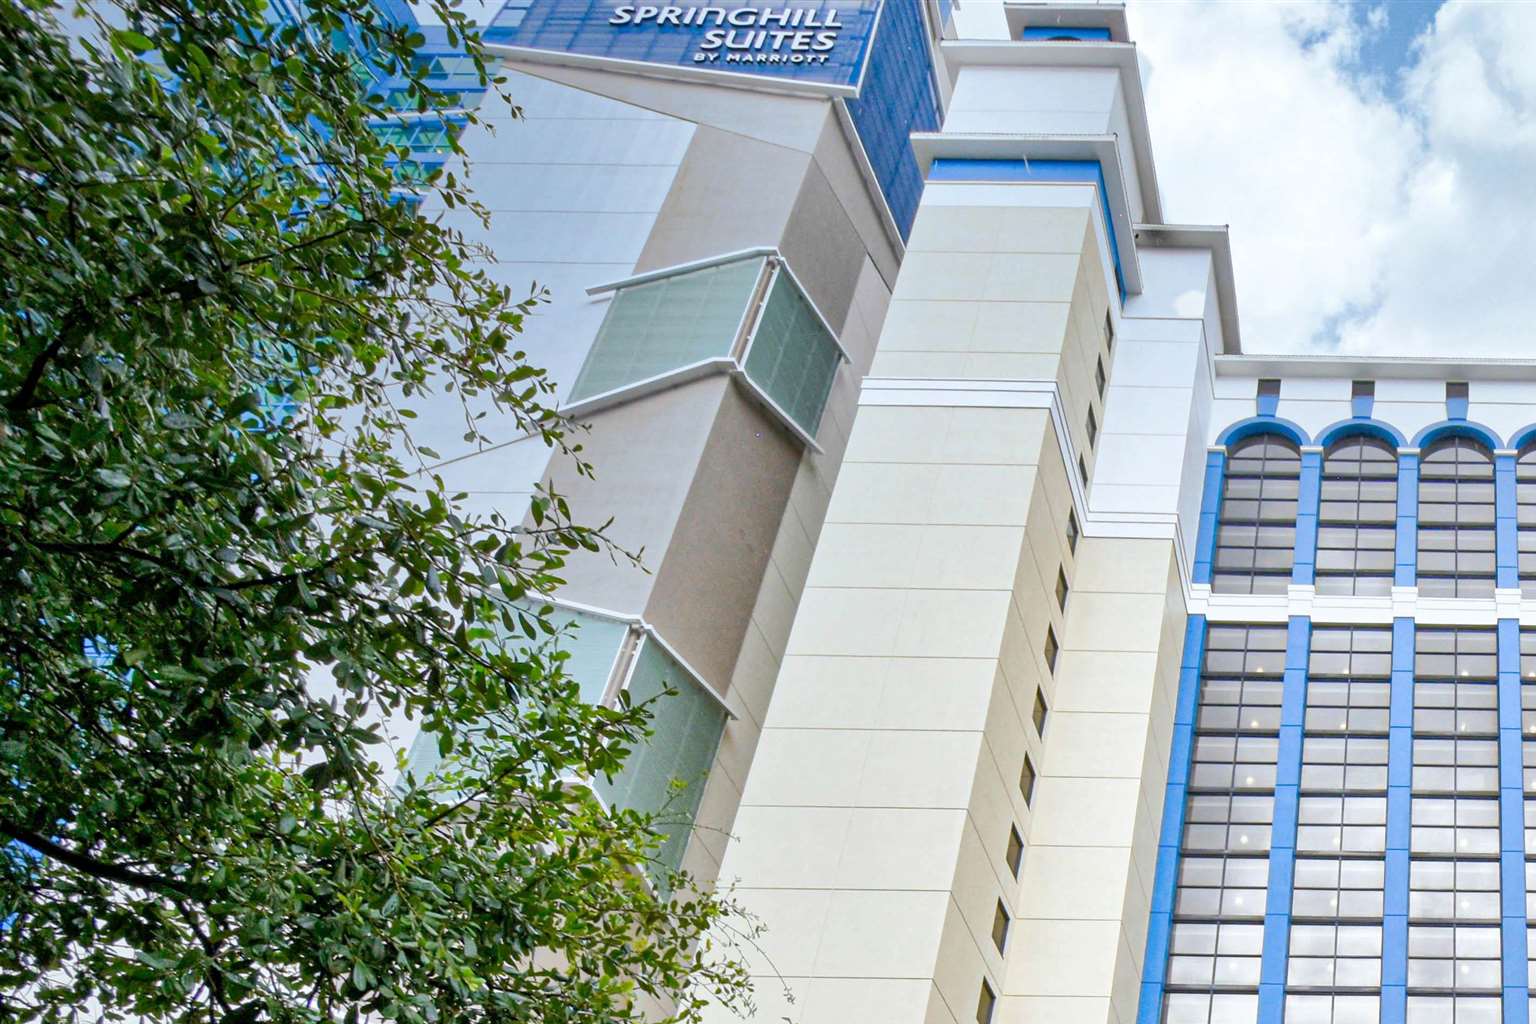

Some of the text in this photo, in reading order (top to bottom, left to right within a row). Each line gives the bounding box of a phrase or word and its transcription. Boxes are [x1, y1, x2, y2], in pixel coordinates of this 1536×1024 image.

[609, 5, 843, 27] SPRINGHILL
[700, 29, 838, 51] SUITES
[693, 52, 829, 64] BY MARRIOTT
